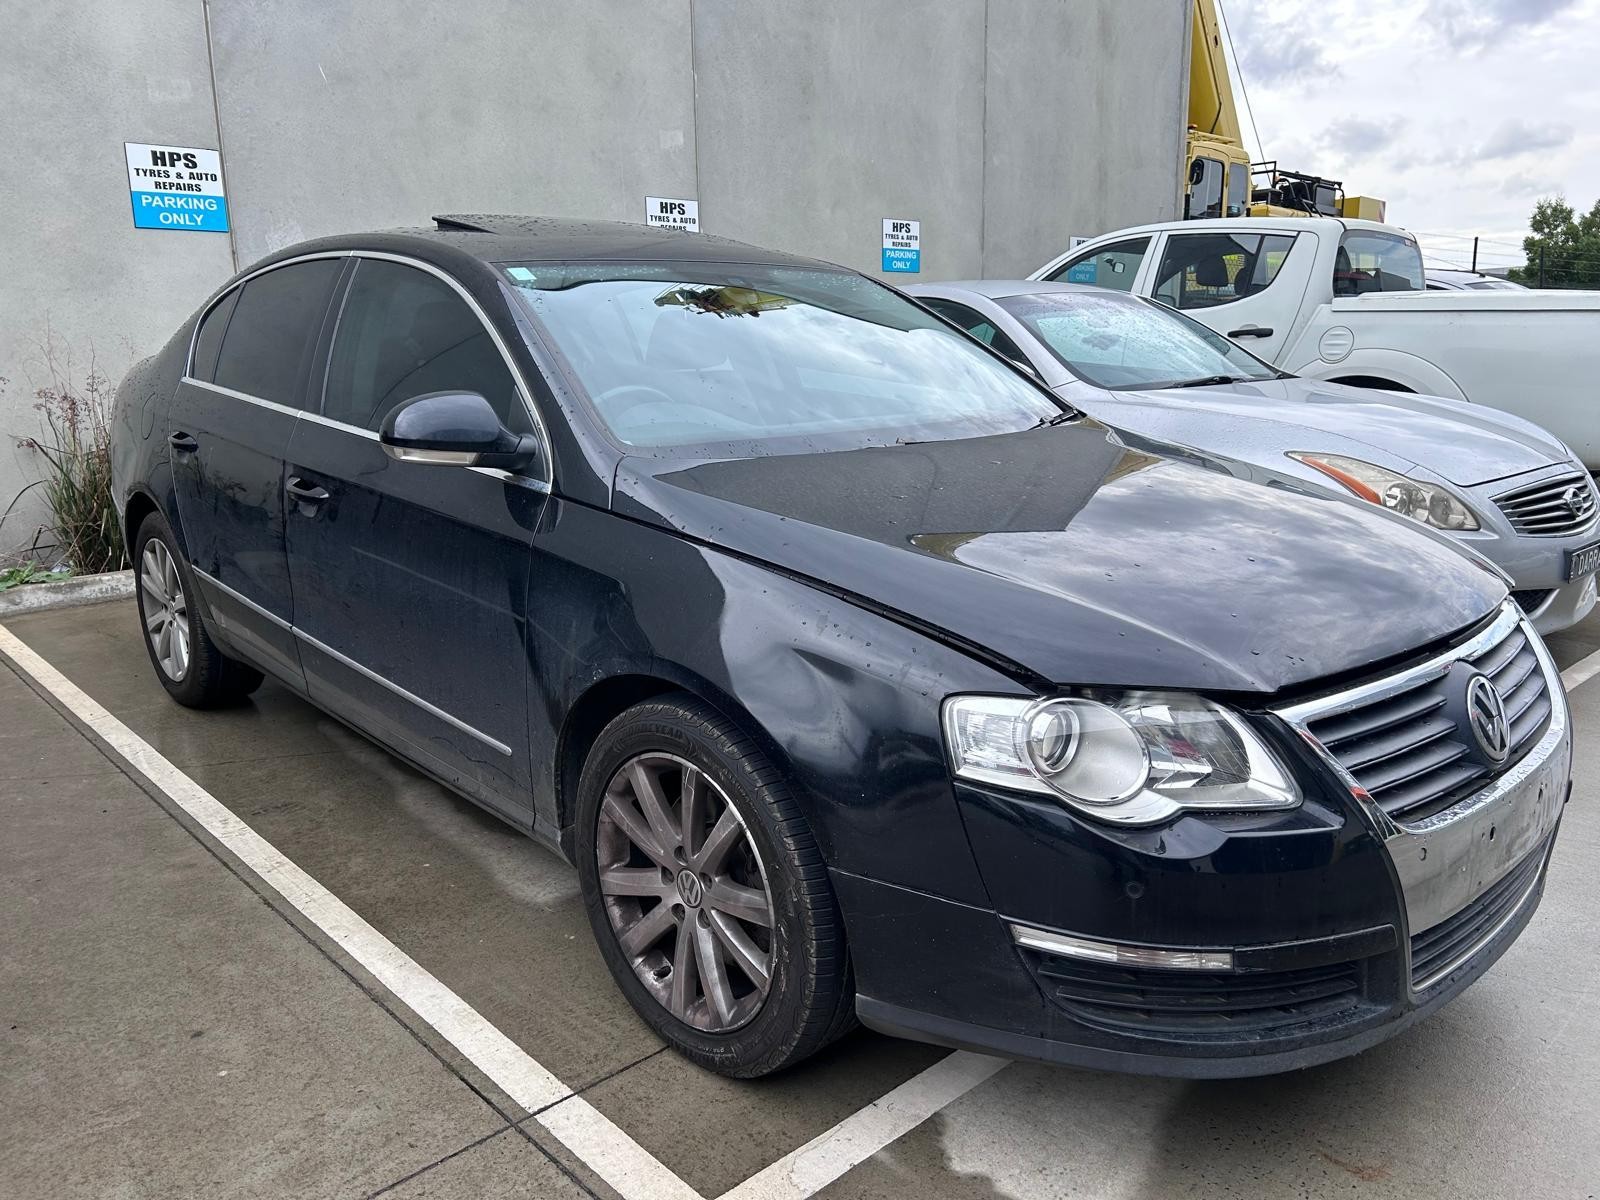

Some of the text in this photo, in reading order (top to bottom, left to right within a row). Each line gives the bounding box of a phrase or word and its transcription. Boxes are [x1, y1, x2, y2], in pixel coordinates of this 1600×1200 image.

[150, 149, 198, 170] HPS
[133, 167, 218, 182] TYRES & AUTO
[154, 180, 202, 192] REPAIRS
[141, 194, 218, 211] PARKING
[659, 201, 686, 216] HPS
[159, 211, 204, 226] ONLY
[649, 214, 670, 223] TYRES
[679, 216, 697, 225] AUTO
[892, 221, 911, 234] HPS
[885, 250, 917, 260] PARKING
[892, 260, 911, 269] ONLY
